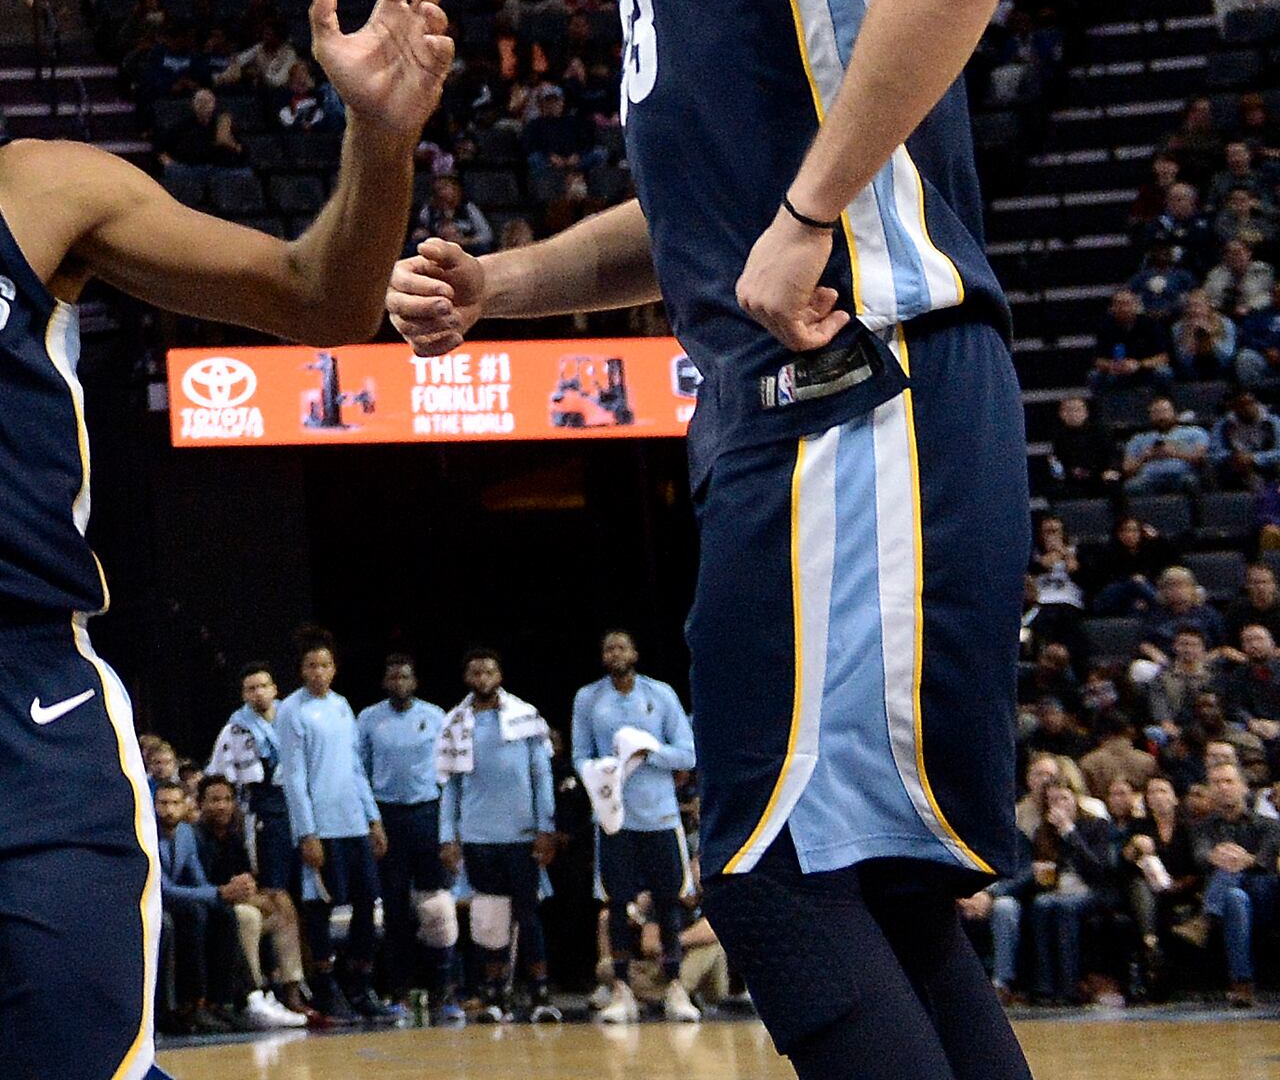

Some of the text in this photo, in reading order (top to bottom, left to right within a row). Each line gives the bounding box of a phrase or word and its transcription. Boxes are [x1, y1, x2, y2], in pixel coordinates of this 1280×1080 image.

[409, 352, 511, 384] THE #1
[411, 384, 512, 413] FORKLIFT
